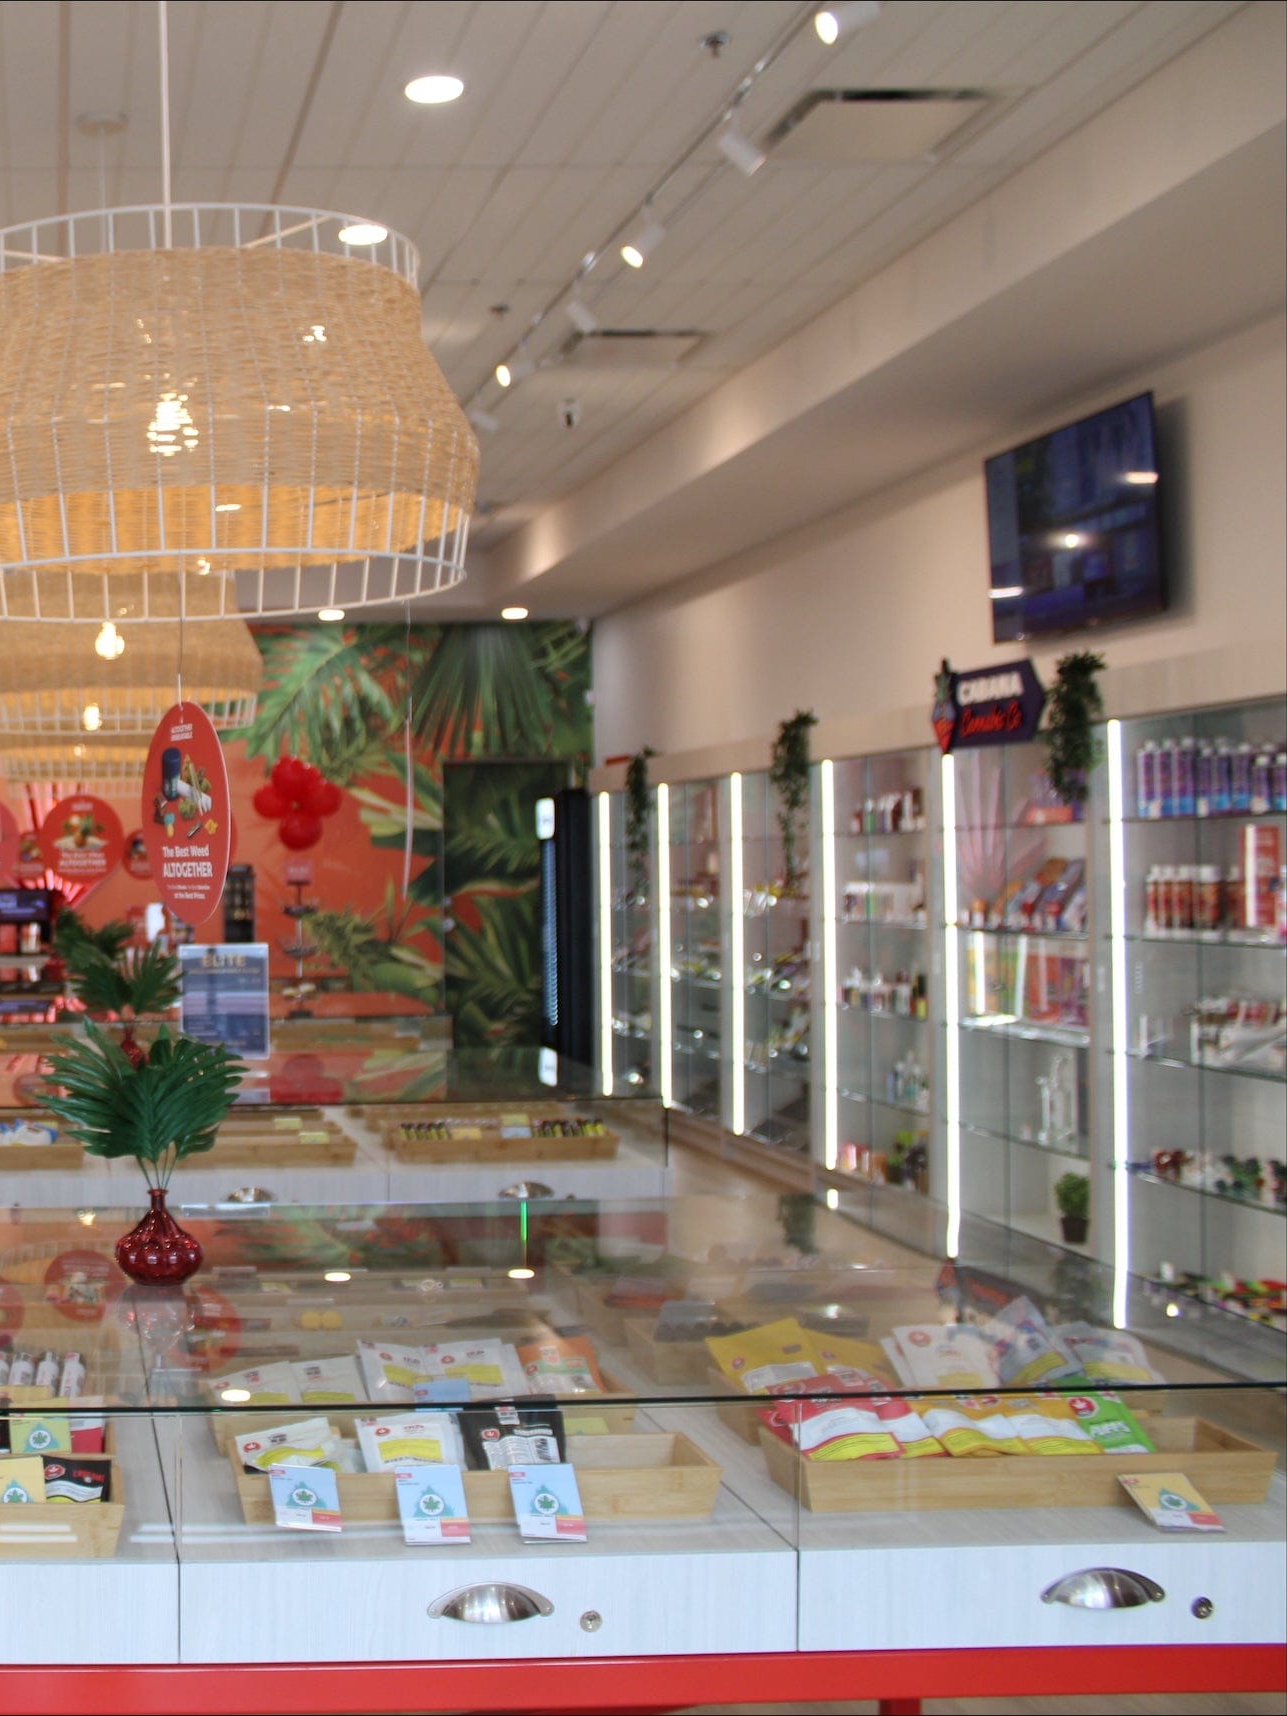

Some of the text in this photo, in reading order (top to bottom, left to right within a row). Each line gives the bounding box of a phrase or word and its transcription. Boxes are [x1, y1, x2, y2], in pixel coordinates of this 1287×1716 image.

[162, 844, 210, 858] The Best Weed
[163, 862, 213, 878] ALTOGETHER
[201, 953, 246, 967] ELITE
